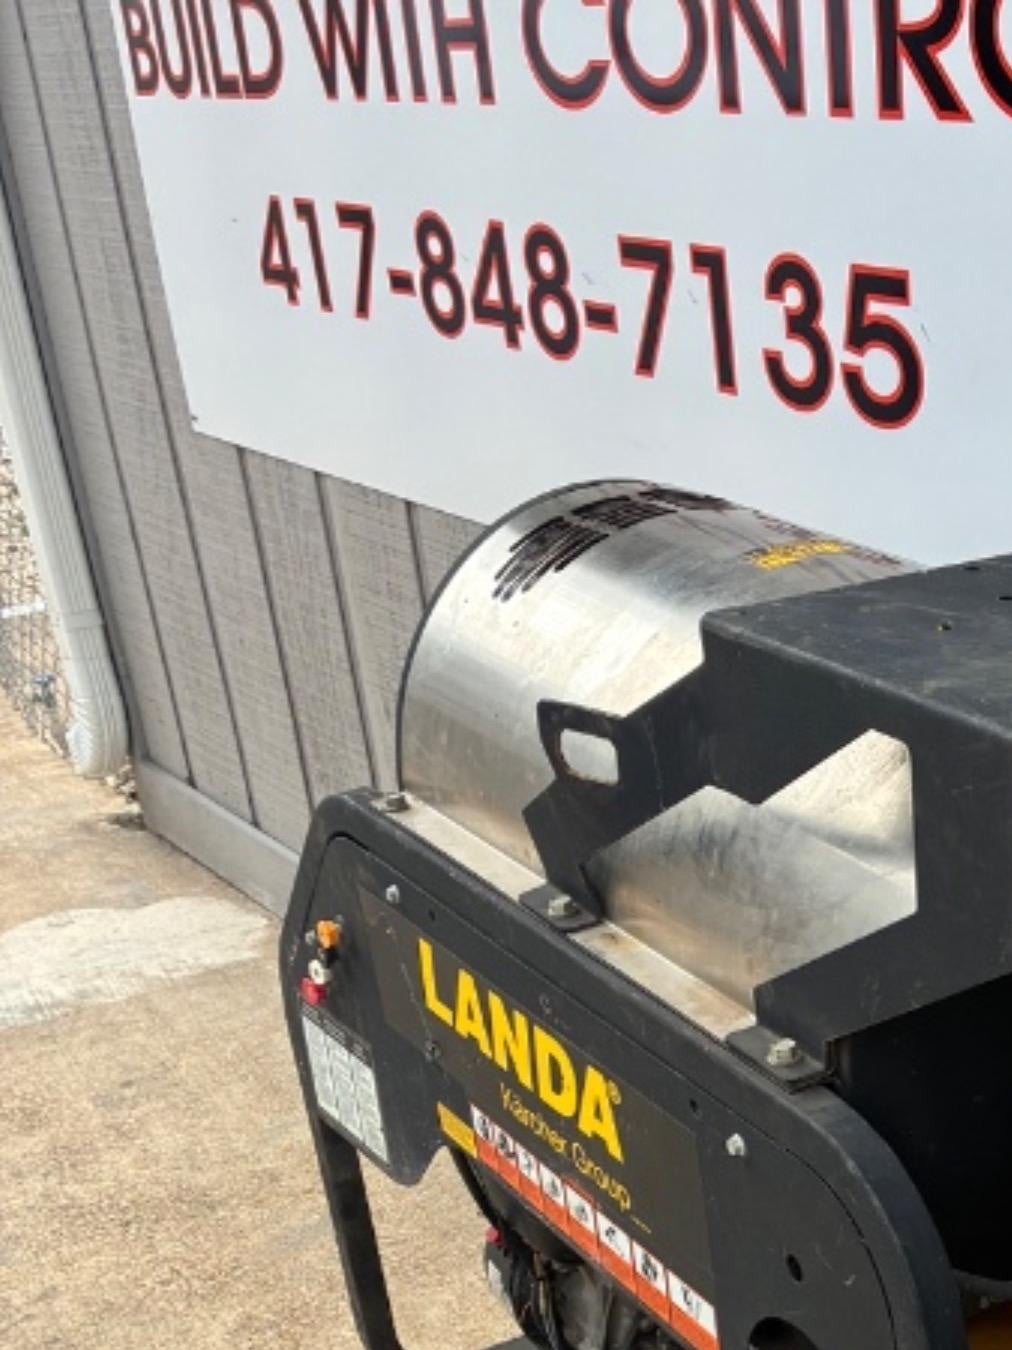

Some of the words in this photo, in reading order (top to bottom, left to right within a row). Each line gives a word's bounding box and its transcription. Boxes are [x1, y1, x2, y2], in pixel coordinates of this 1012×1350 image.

[121, 0, 284, 99] BUILD
[260, 195, 925, 430] 417-848-7135
[572, 1141, 632, 1213] Group
